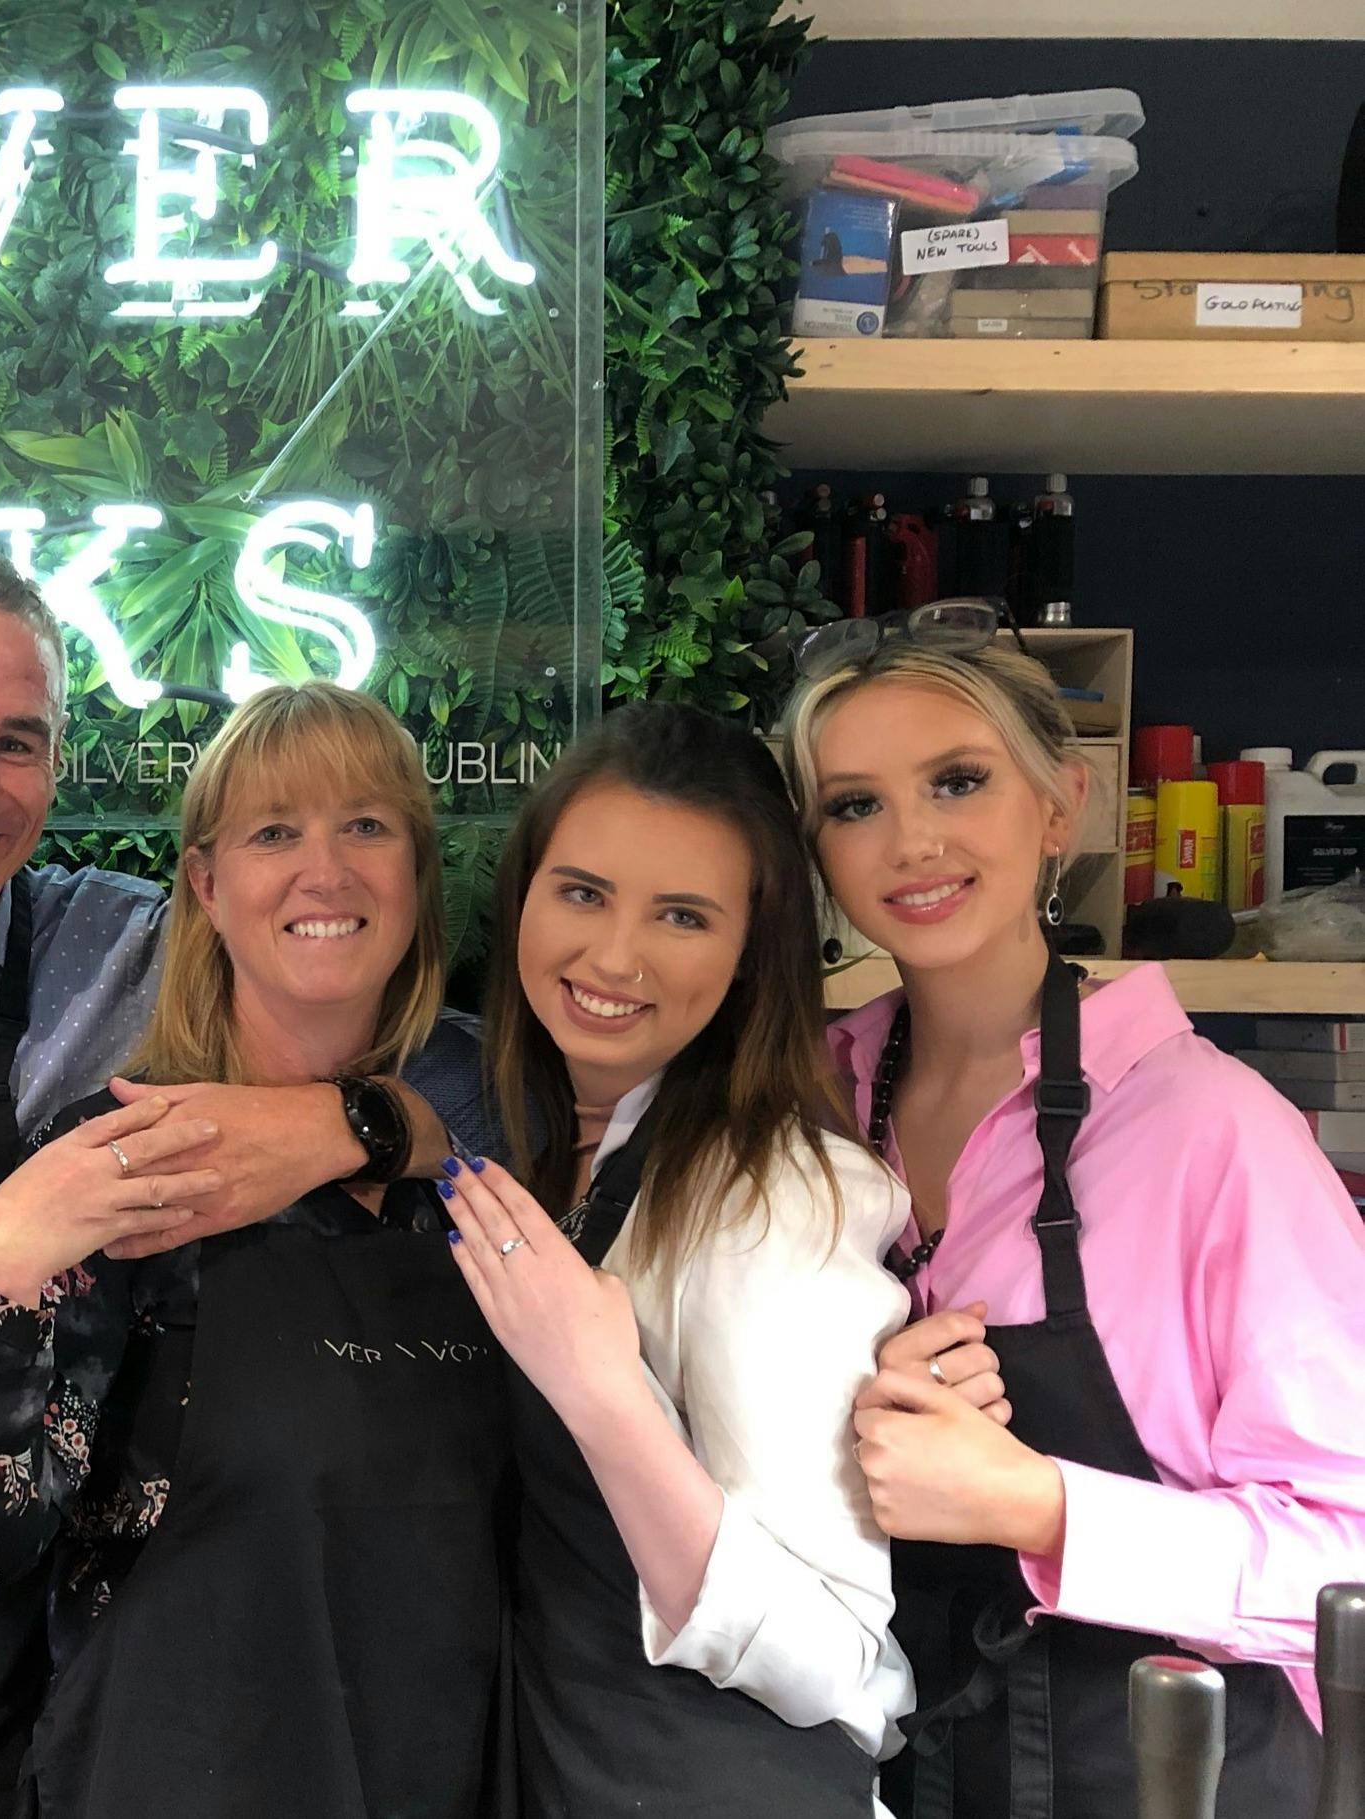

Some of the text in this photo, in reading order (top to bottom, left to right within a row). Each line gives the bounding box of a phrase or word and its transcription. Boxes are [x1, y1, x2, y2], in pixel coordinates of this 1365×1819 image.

[927, 227, 980, 242] (SPARE)
[916, 240, 998, 261] NEW TOOLS
[1204, 295, 1247, 311] GOLD
